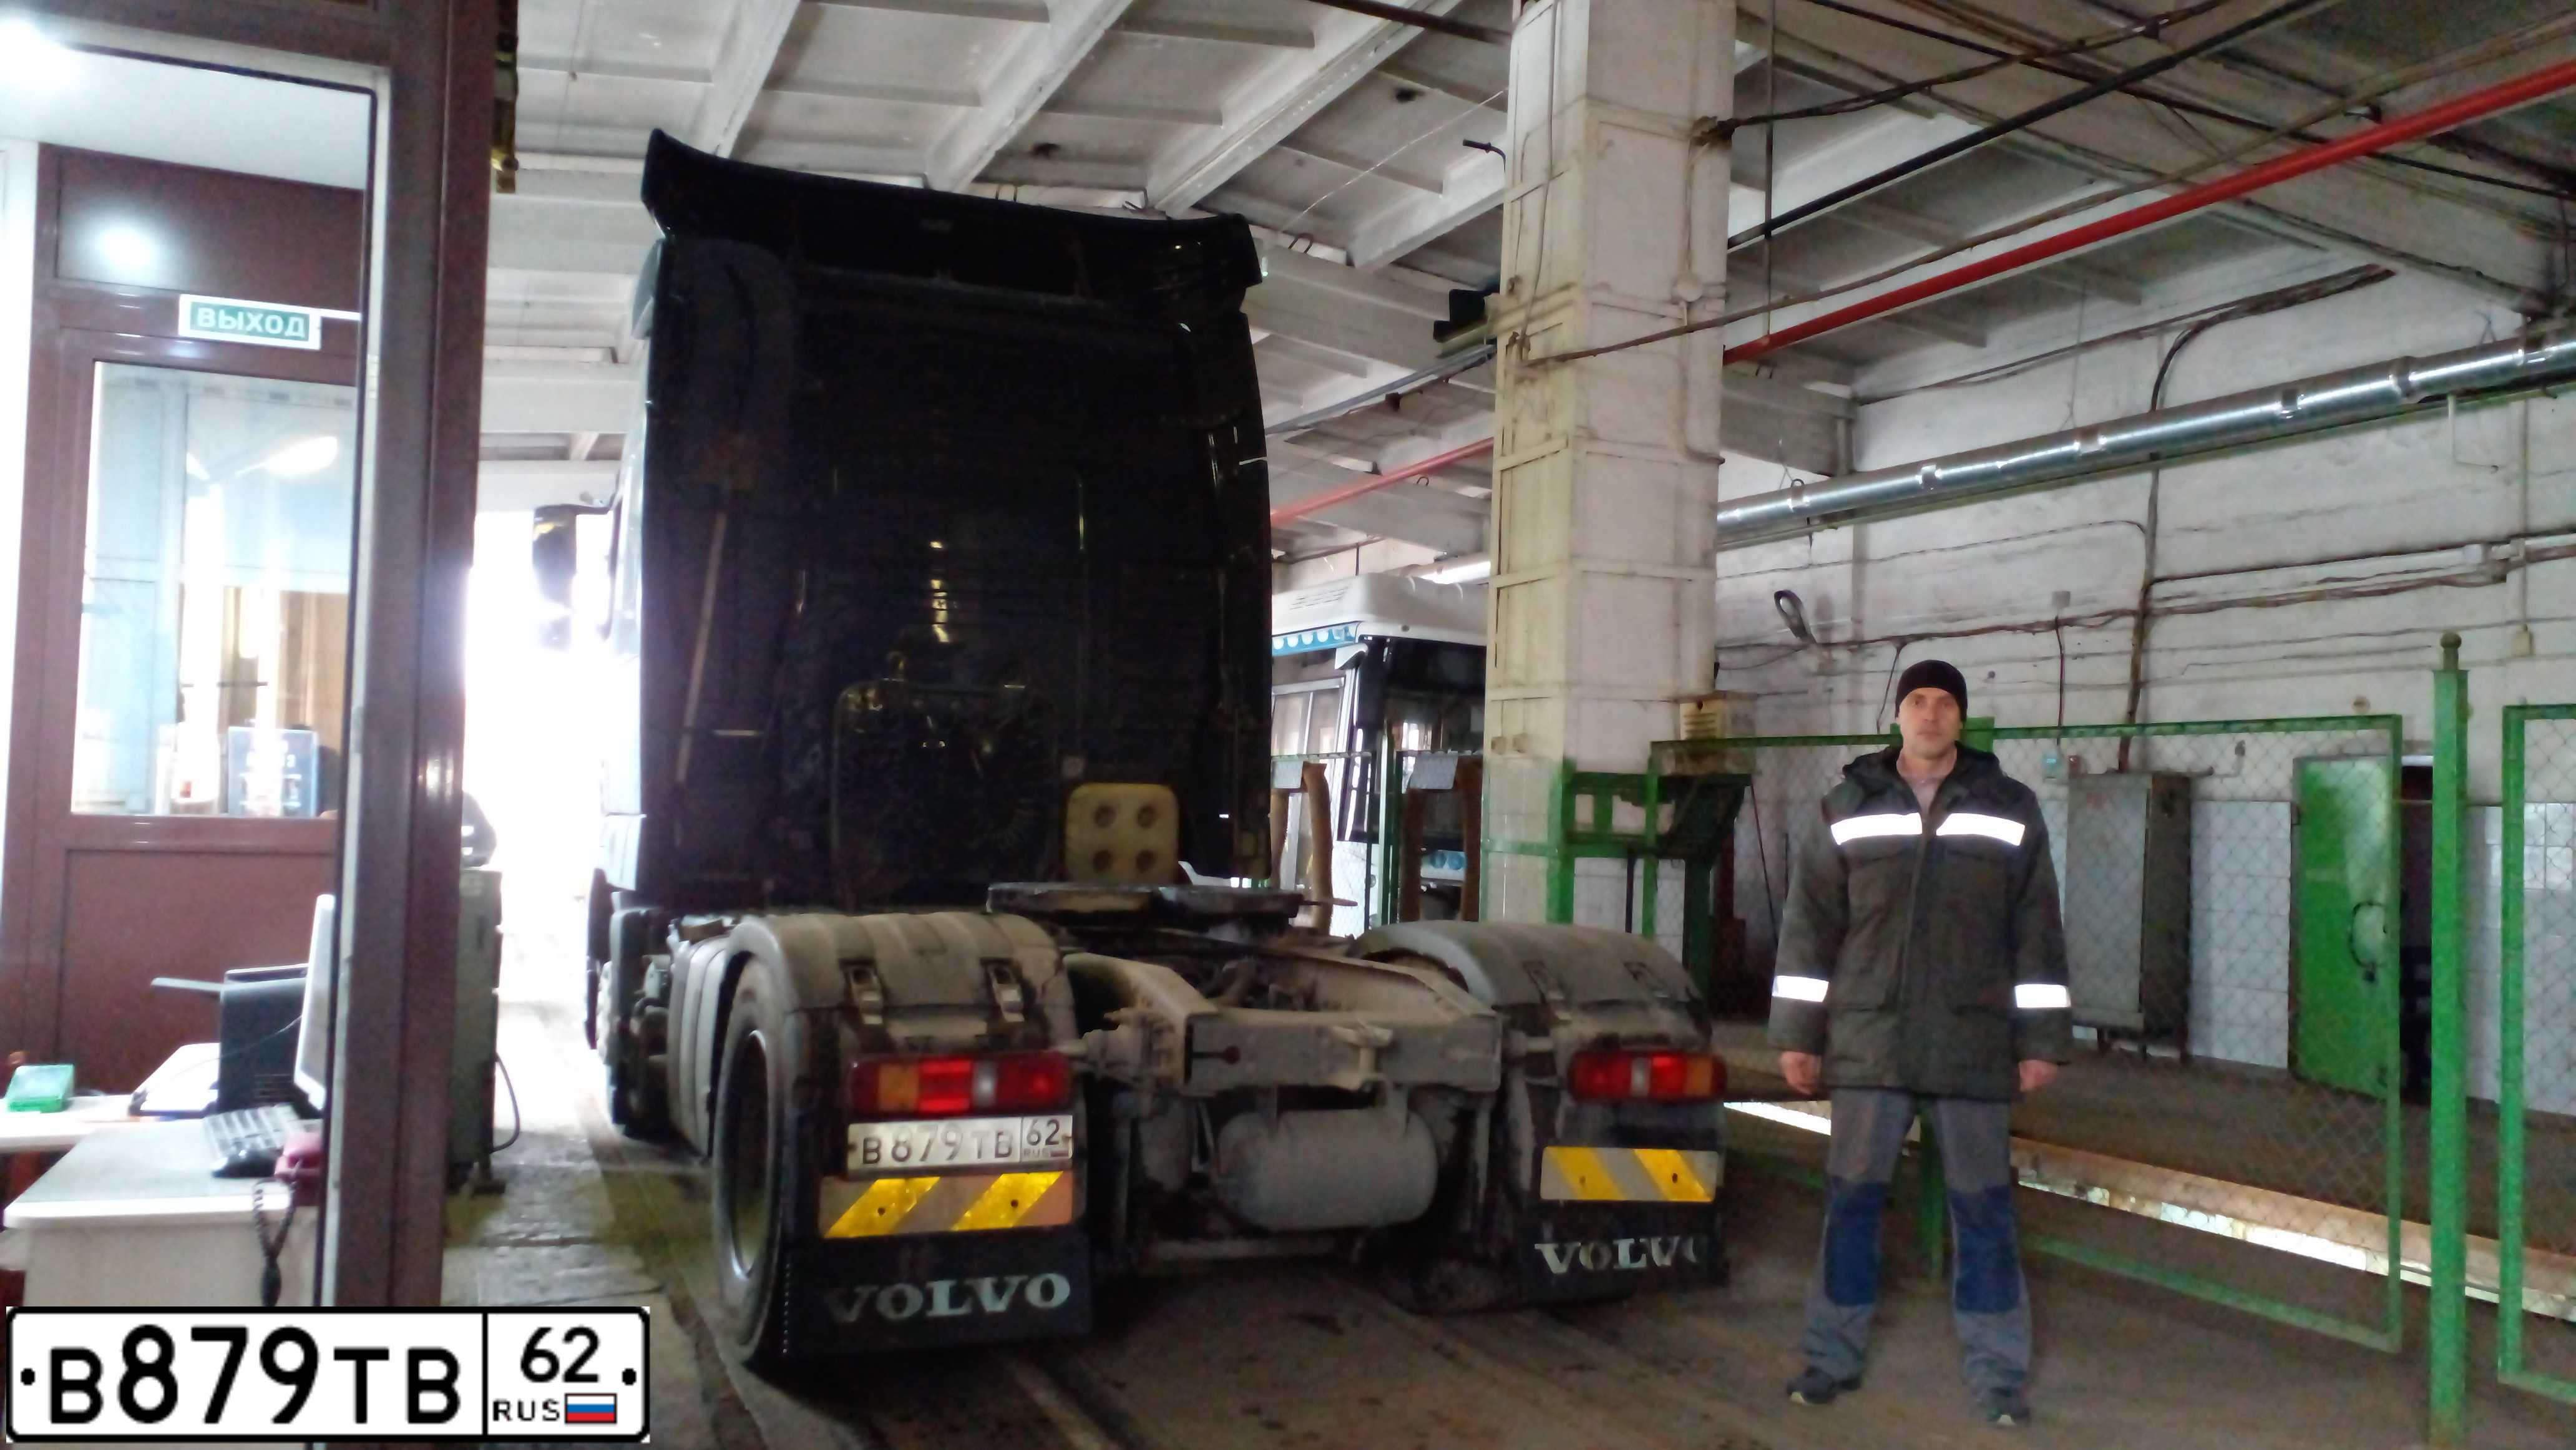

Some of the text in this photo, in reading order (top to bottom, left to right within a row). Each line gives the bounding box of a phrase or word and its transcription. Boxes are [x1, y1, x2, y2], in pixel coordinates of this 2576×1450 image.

[197, 306, 306, 338] ВЫХОД
[862, 1117, 1060, 1165] В879ТВ 62
[819, 1273, 1071, 1323] VOLVO
